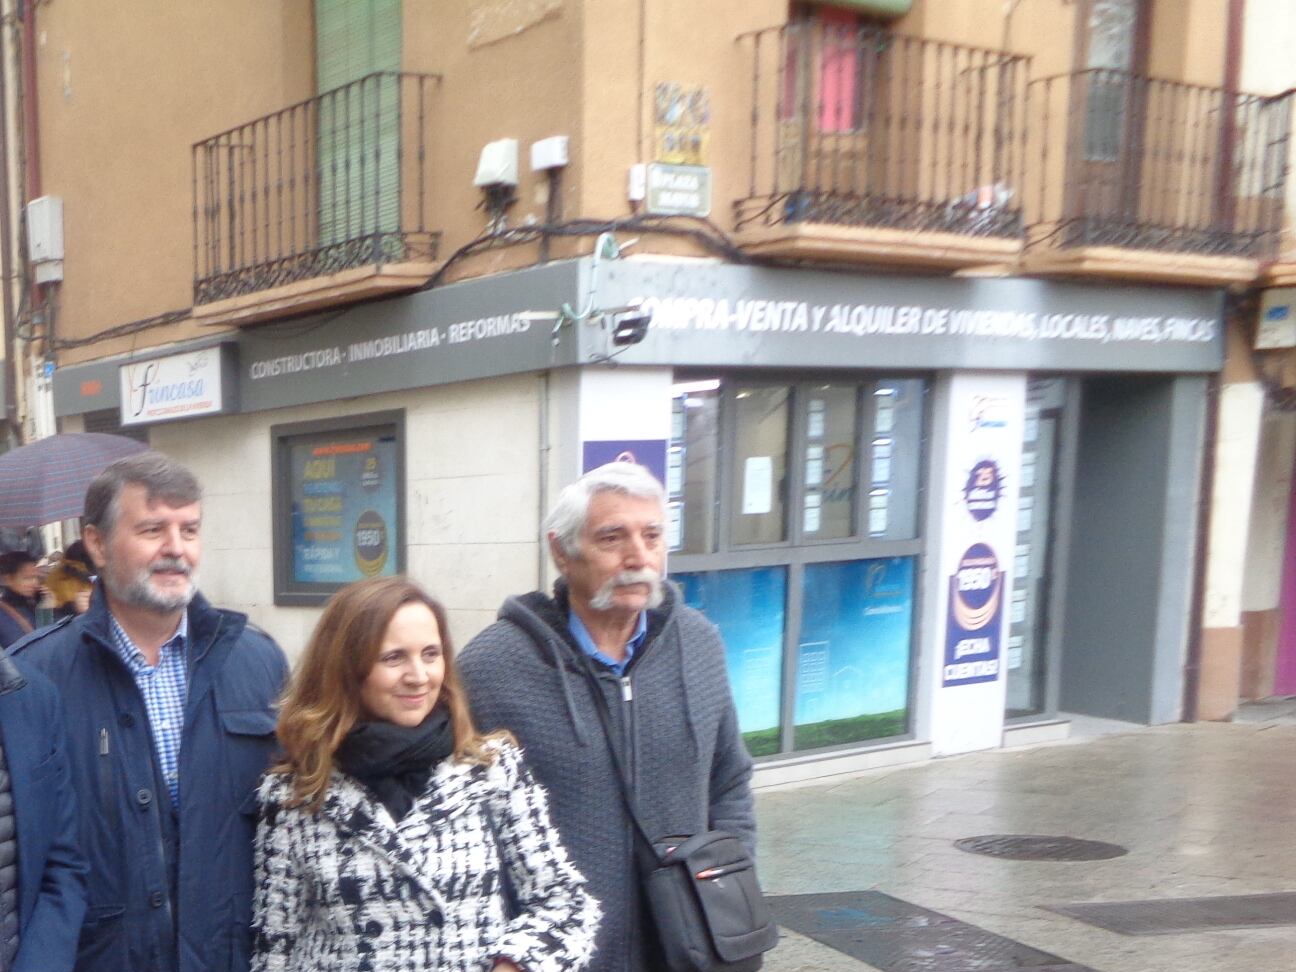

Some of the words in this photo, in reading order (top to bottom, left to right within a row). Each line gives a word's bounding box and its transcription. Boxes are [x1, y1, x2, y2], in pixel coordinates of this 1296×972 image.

[249, 346, 341, 380] CONSTRUCTORA
[349, 330, 440, 363] INMOBILIARIA
[449, 312, 531, 344] REFORMAS
[810, 305, 827, 331] Y
[825, 304, 921, 336] ALQUILER
[920, 308, 950, 335] DE
[1039, 313, 1111, 344] LOCALES,
